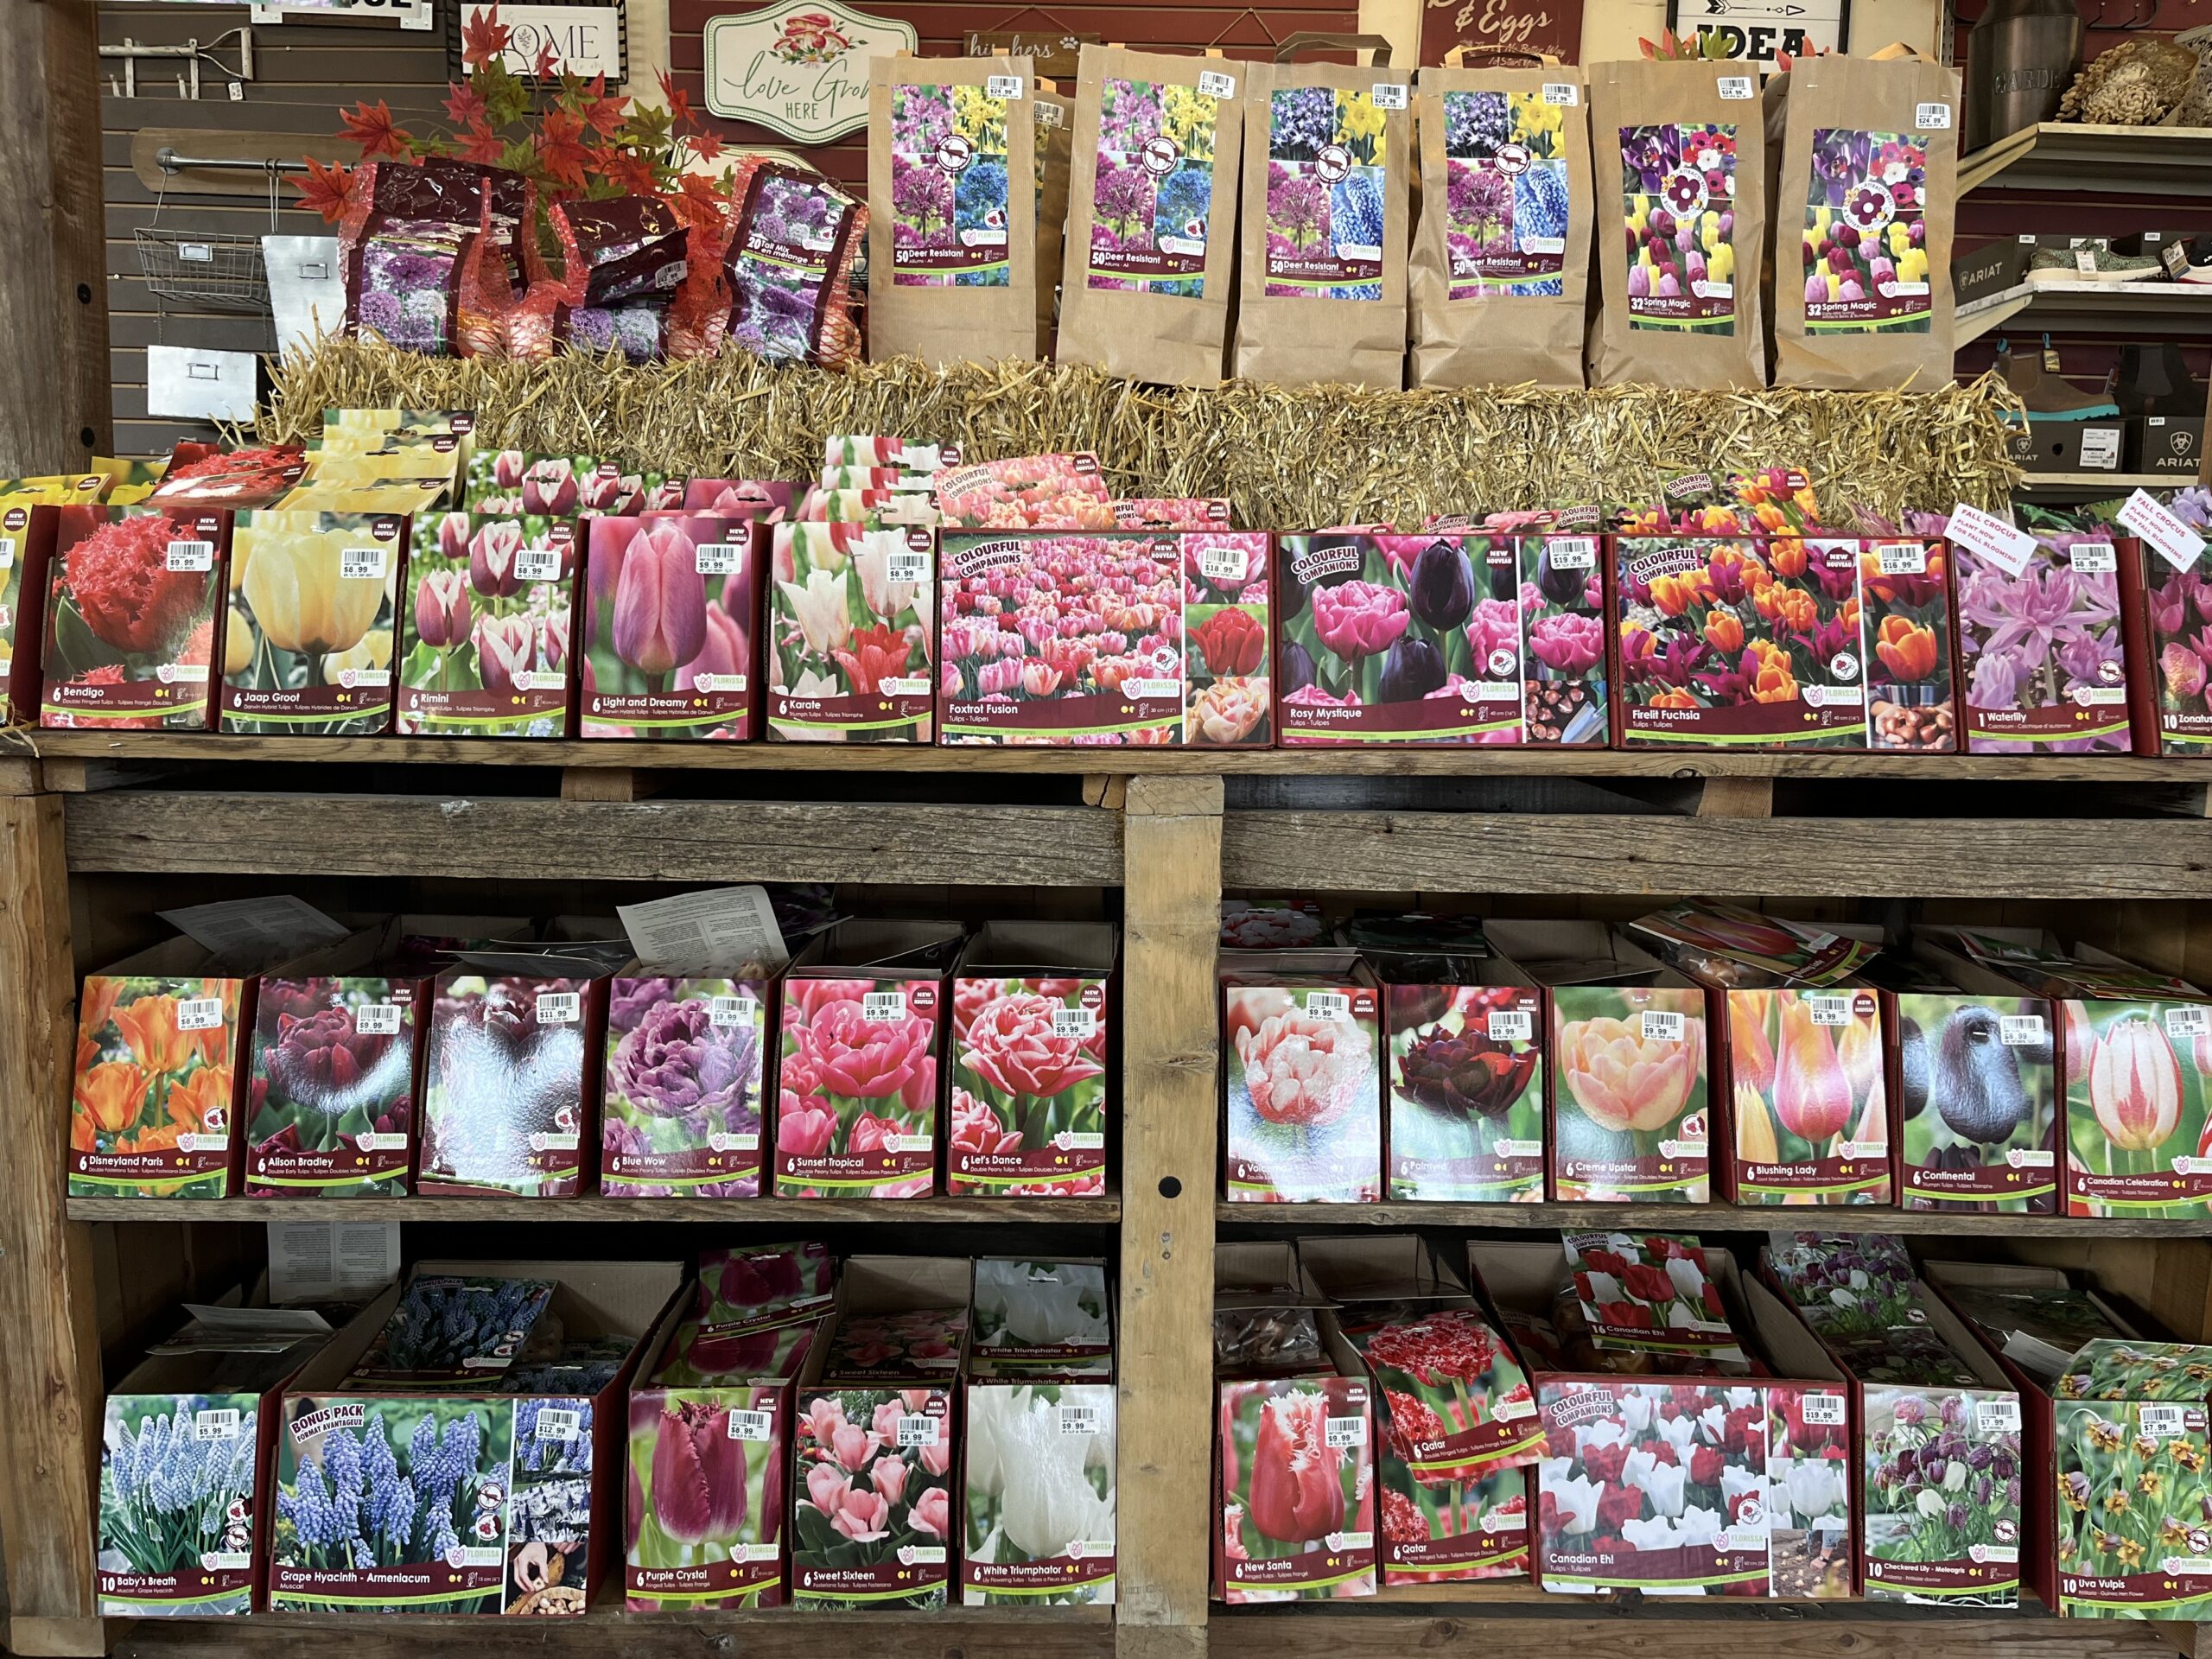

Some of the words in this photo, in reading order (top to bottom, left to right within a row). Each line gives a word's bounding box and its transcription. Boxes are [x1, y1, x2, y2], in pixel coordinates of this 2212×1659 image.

[1478, 0, 1553, 42] Eggs
[502, 23, 600, 60] OME
[1012, 35, 1054, 58] hers
[1546, 45, 1566, 57] Way
[723, 51, 800, 99] love
[785, 102, 819, 119] HERE
[747, 237, 761, 250] 20
[761, 240, 773, 250] Tall
[775, 244, 790, 254] Mix
[773, 251, 808, 264] mélange
[896, 250, 908, 263] 50
[909, 249, 927, 258] Deer
[930, 249, 964, 258] Resistant
[1968, 262, 2003, 286] ARIAT
[1630, 297, 1644, 310] 32
[1644, 297, 1665, 308] Spring
[1667, 298, 1691, 309] Magic
[2156, 458, 2201, 467] ARIAT
[1961, 509, 1982, 522] FALL
[1984, 519, 2018, 540] CROCUS
[2137, 497, 2154, 513] FALL
[2156, 512, 2186, 537] CROCUS
[1957, 518, 1978, 531] PLANT
[1979, 529, 1995, 540] NOW
[1954, 525, 1967, 535] FOR
[1967, 532, 1982, 543] FALL
[1983, 541, 2017, 563] BLOOMING
[954, 541, 1021, 566] COLOURFUL
[1150, 551, 1177, 560] NOUVEAU
[1290, 546, 1358, 574] COLOURFUL
[1629, 547, 1697, 575] COLOURFUL
[170, 558, 194, 567] $9.99
[961, 553, 1021, 577] COMPANIONS
[1205, 564, 1233, 574] $18.99
[1297, 558, 1359, 585] COMPANIONS
[1637, 561, 1696, 585] COMPANIONS
[531, 674, 563, 683] FLORISSA
[1142, 681, 1178, 690] FLORISSA
[53, 687, 60, 702] 6
[63, 687, 105, 699] Bendigo
[233, 692, 242, 708] 6
[244, 692, 270, 704] Jaap
[272, 692, 300, 702] Groot
[410, 694, 418, 709] 6
[421, 693, 449, 703] Rimini
[592, 697, 601, 712] 6
[602, 697, 626, 709] Light
[628, 697, 647, 708] and
[649, 697, 688, 709] Dreamy
[779, 701, 787, 715] 6
[789, 701, 821, 709] Karate
[949, 704, 984, 714] Foxtrot
[987, 704, 1018, 714] Fusion
[1290, 708, 1313, 720] Rosy
[1316, 708, 1363, 720] Mystique
[1632, 709, 1659, 721] Firelit
[1662, 709, 1700, 721] Fuchsia
[1978, 713, 1985, 728] 1
[1987, 712, 2027, 723] Waterlily
[2164, 715, 2177, 729] 10
[79, 1157, 87, 1171] 6
[89, 1156, 140, 1167] Disneyland
[142, 1156, 163, 1166] Paris
[258, 1157, 265, 1173] 6
[268, 1157, 296, 1166] Alison
[298, 1157, 334, 1168] Bradley
[612, 1157, 620, 1172] 6
[622, 1156, 642, 1166] Blue
[644, 1157, 666, 1166] Wow
[787, 1158, 795, 1173] 6
[797, 1158, 826, 1167] Sunset
[828, 1158, 864, 1169] Tropical
[961, 1155, 969, 1171] 6
[970, 1155, 990, 1165] Let's
[992, 1155, 1022, 1165] Dance
[1566, 1162, 1573, 1177] 6
[1576, 1162, 1605, 1173] Creme
[1608, 1162, 1637, 1174] Upstar
[1747, 1166, 1755, 1180] 6
[1756, 1166, 1792, 1177] Blushing
[1795, 1166, 1817, 1177] Lady
[1913, 1171, 1922, 1185] 6
[1923, 1171, 1975, 1182] Continental
[2077, 1178, 2086, 1192] 6
[2087, 1177, 2124, 1186] Canadian
[2126, 1178, 2169, 1187] Celebration
[1592, 1325, 1605, 1334] 16
[1606, 1325, 1649, 1335] Canadian
[981, 1347, 988, 1356] 6
[1014, 1347, 1062, 1356] Triumphator
[1549, 1389, 1613, 1415] COLOURFUL
[291, 1407, 331, 1434] BONUS
[334, 1404, 365, 1418] PACK
[1556, 1402, 1614, 1427] COMPANIONS
[1806, 1411, 1833, 1420] $19.99
[296, 1427, 322, 1443] FORMAT
[322, 1418, 363, 1438] AVANTAGEUX
[539, 1426, 566, 1434] $12.99
[1393, 1545, 1401, 1560] 6
[1402, 1543, 1427, 1554] Qatar
[1549, 1554, 1598, 1565] Canadian
[1599, 1554, 1614, 1565] Eh!
[281, 1570, 312, 1584] Grape
[315, 1570, 357, 1584] Hyacinth
[366, 1572, 430, 1584] Armeniacum
[973, 1567, 982, 1582] 6
[983, 1566, 1007, 1575] White
[1009, 1565, 1062, 1577] Triumphator
[1236, 1563, 1243, 1579] 6
[1245, 1561, 1265, 1571] New
[1267, 1560, 1292, 1570] Santa
[1868, 1563, 1882, 1578] 10
[1884, 1563, 1917, 1573] Checkered
[1919, 1565, 1929, 1575] Lily
[1936, 1566, 1965, 1575] Meleagris
[101, 1576, 115, 1592] 10
[118, 1575, 146, 1587] Baby's
[148, 1575, 177, 1586] Breath
[637, 1571, 645, 1587] 6
[646, 1569, 675, 1582] Purple
[677, 1569, 707, 1582] Crystal
[804, 1572, 812, 1586] 6
[813, 1571, 840, 1581] Sweet
[842, 1570, 875, 1580] Sixteen
[2063, 1579, 2076, 1594] 10
[2078, 1580, 2096, 1588] Uva
[2099, 1580, 2126, 1590] Vulpis
